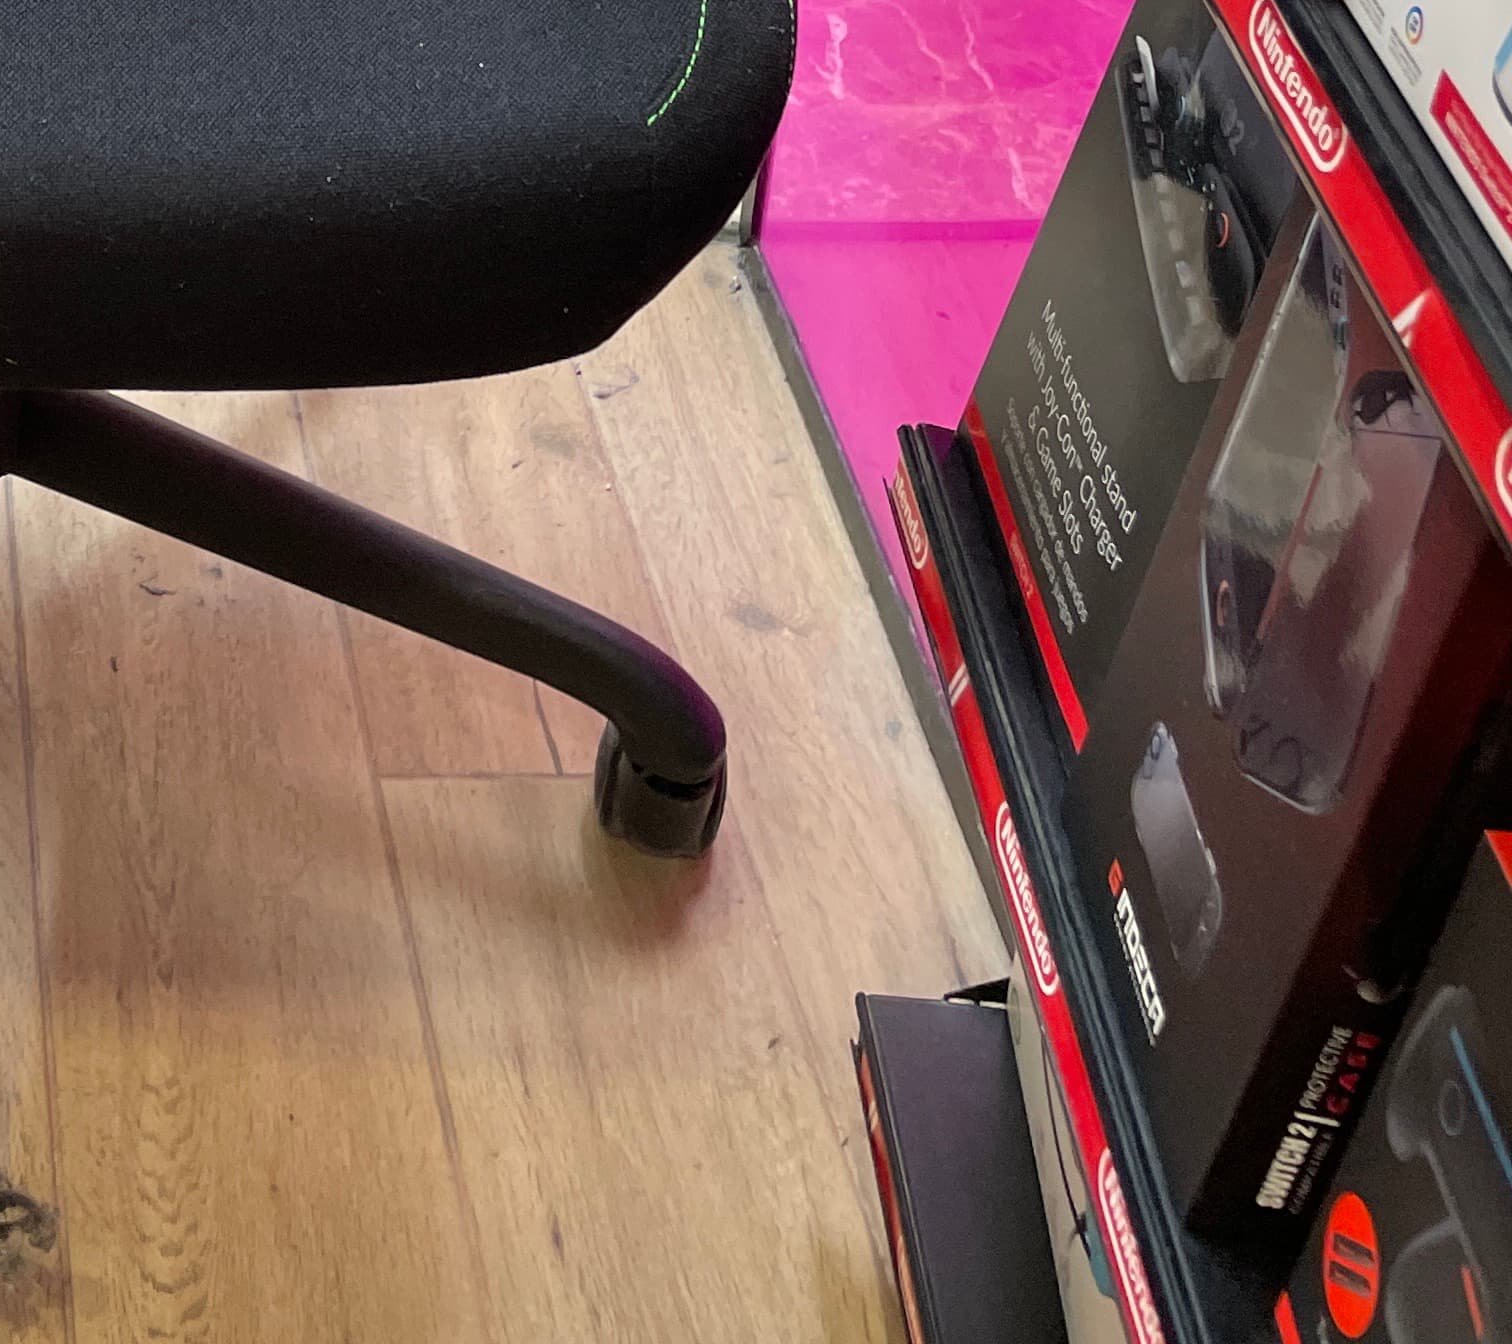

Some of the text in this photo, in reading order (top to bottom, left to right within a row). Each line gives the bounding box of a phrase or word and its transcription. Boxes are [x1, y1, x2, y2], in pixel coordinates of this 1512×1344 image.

[1256, 8, 1335, 153] Nintendo
[1026, 330, 1048, 382] with
[1079, 474, 1122, 572] Charger
[1036, 426, 1062, 499] Game
[1058, 489, 1084, 555] Slots
[1041, 298, 1137, 534] Multi-functional stand
[1001, 816, 1053, 977] Nintendo
[1256, 1026, 1354, 1210] SWITCH 2 PROTECTIVE
